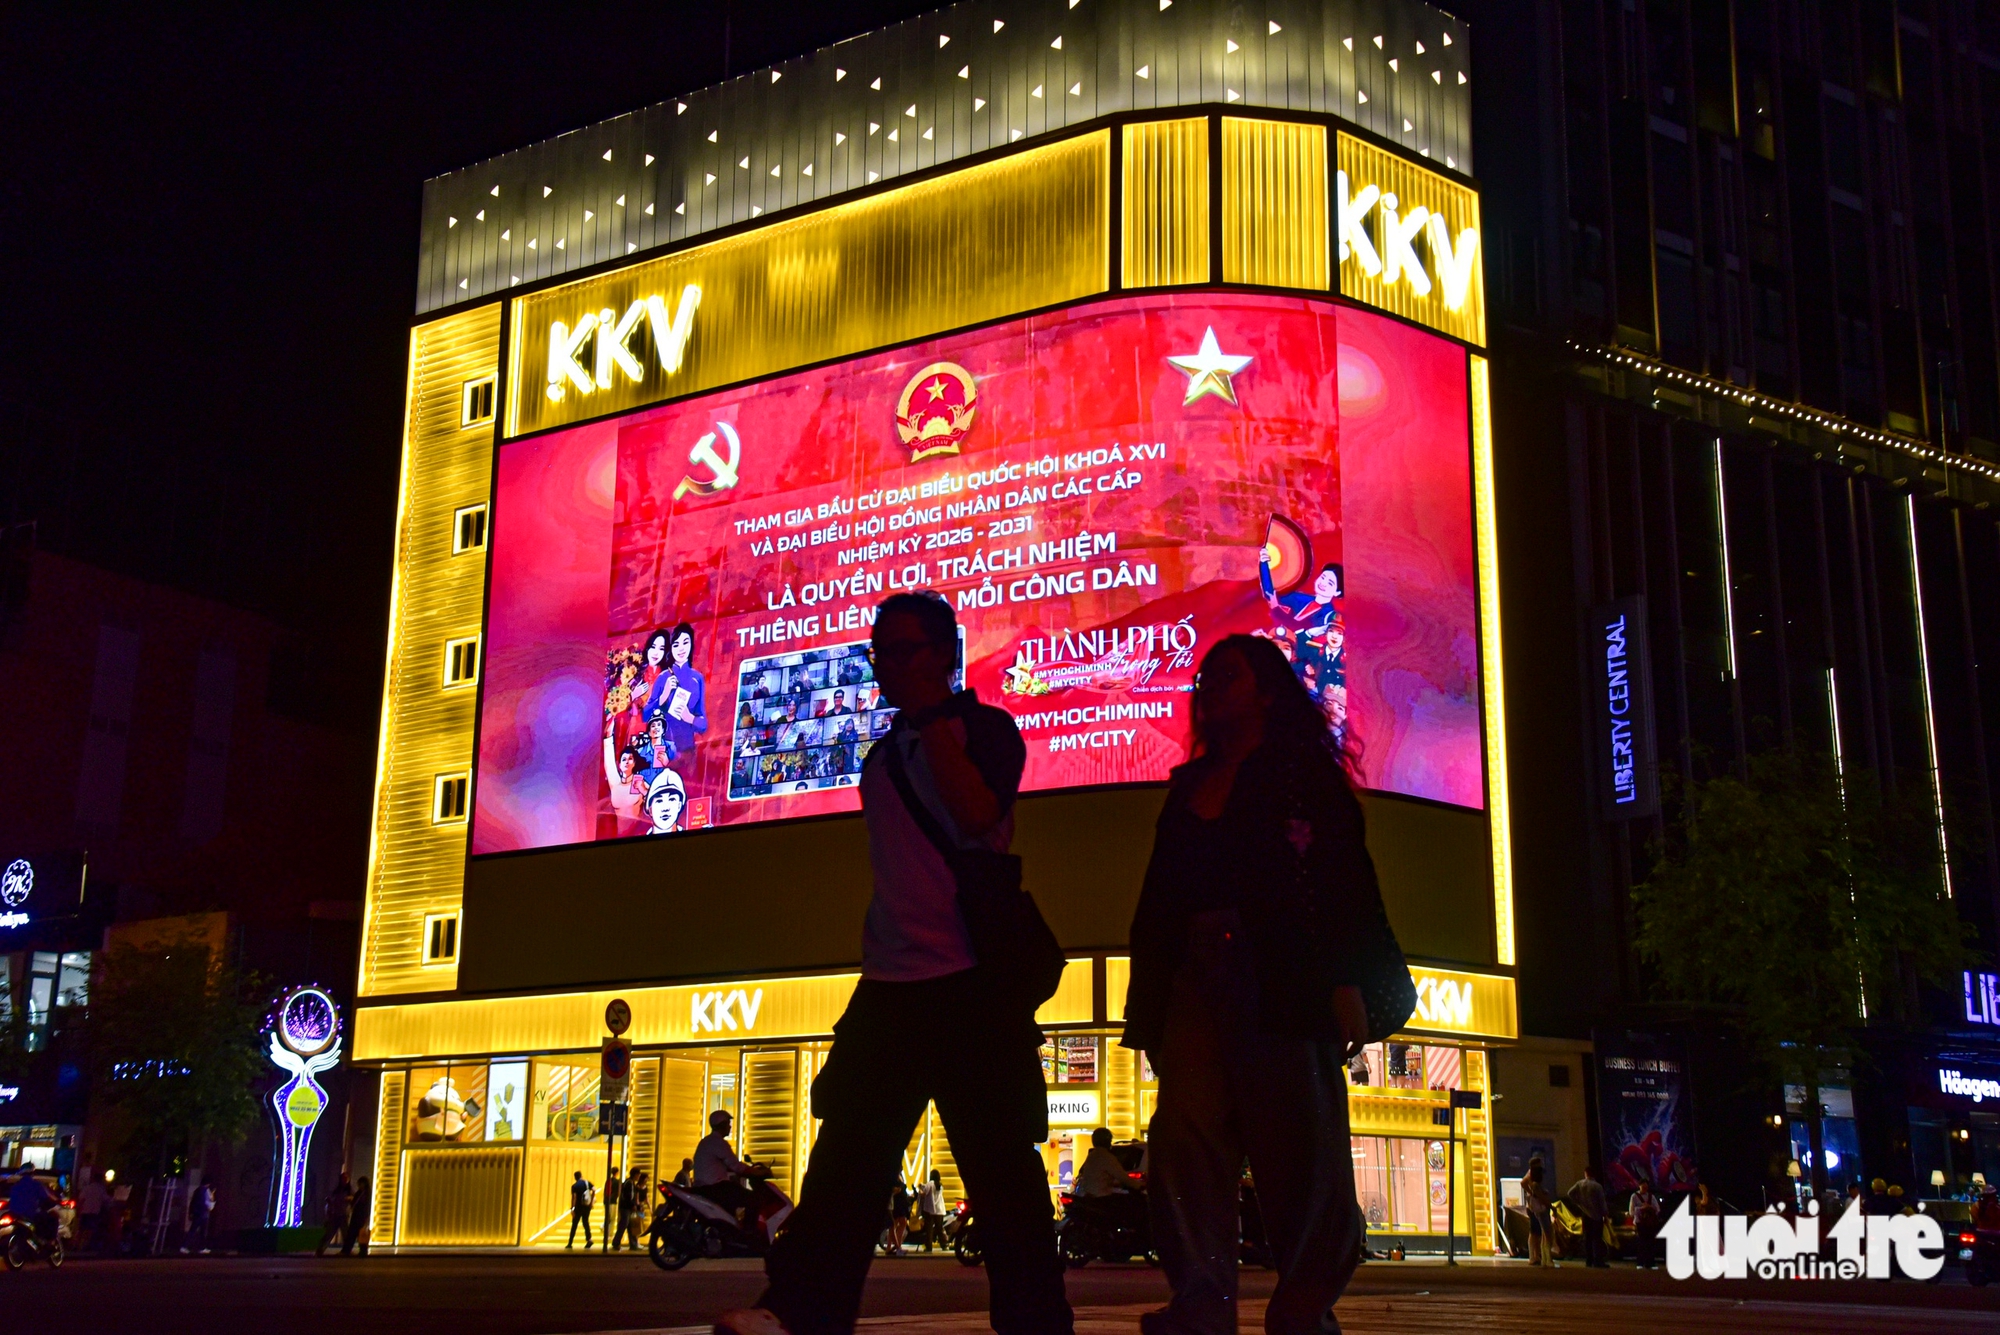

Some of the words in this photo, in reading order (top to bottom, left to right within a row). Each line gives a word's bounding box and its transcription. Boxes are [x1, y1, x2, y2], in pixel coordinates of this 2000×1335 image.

[1337, 170, 1478, 311] KKV
[547, 284, 702, 402] KKV
[734, 513, 781, 535] THAM
[785, 506, 813, 526] GIA
[817, 495, 853, 519] BẦU
[858, 489, 883, 510] CỬ
[885, 486, 916, 505] ĐẠI
[920, 472, 963, 498] BIỂU
[967, 461, 1021, 491] QUỐC
[1026, 455, 1059, 477] HỘI
[1064, 443, 1124, 475] KHOÁ
[1129, 443, 1165, 461] XVI
[751, 536, 774, 557] VÀ
[777, 533, 806, 553] ĐẠI
[810, 520, 850, 546] BIỂU
[854, 515, 885, 537] HỘI
[889, 506, 941, 531] ĐỒNG
[946, 494, 1000, 519] NHÂN
[1005, 485, 1047, 508] DÂN
[1052, 477, 1092, 499] CÁC
[1096, 467, 1142, 492] CẤP
[767, 584, 796, 611] LÀ
[801, 567, 882, 607] QUYỀN
[889, 562, 932, 591] LỢI,
[937, 546, 1022, 580] TRÁCH
[1028, 530, 1116, 565] NHIỆM
[838, 541, 894, 566] NHIỆM
[898, 533, 923, 555] KỲ
[925, 526, 973, 550] 2026
[988, 515, 1033, 539] 2031
[736, 617, 820, 648] THIÊNG
[826, 604, 880, 633] LIÊN
[957, 576, 1003, 611] MỖI
[1009, 573, 1085, 602] CÔNG
[1092, 561, 1157, 591] DÂN
[1020, 627, 1118, 664] THÀNH
[1128, 613, 1197, 653] PHỐ
[1033, 662, 1113, 679] #MYHOCHIMINH
[1605, 614, 1630, 715] CENTRAL
[1049, 675, 1093, 689] #MYCITY
[1014, 701, 1173, 731] #MYHOCHIMINH
[1049, 729, 1137, 753] #MYCITY
[1611, 719, 1636, 804] LIBERTY
[691, 988, 763, 1033] KKV
[1605, 1057, 1636, 1070] BUSINESS
[1637, 1059, 1658, 1072] LUNCH
